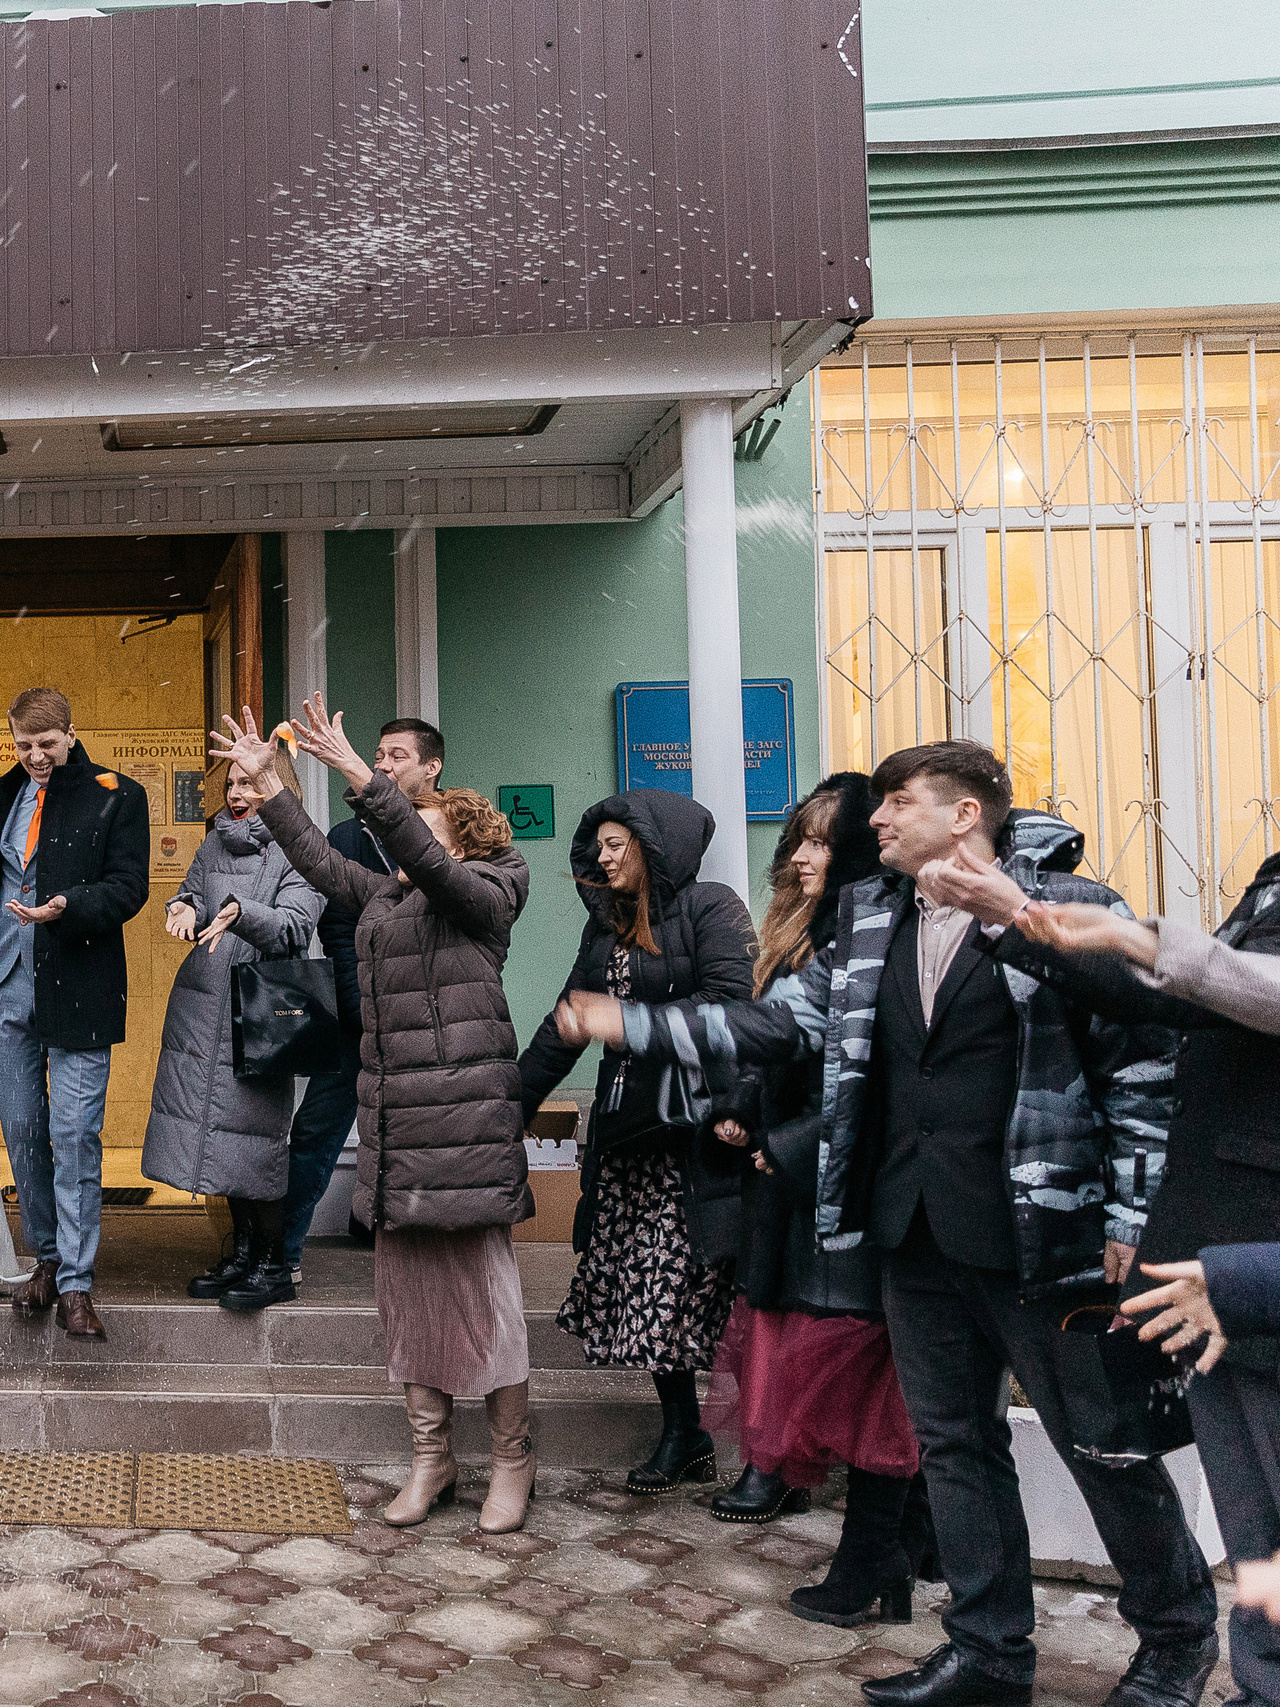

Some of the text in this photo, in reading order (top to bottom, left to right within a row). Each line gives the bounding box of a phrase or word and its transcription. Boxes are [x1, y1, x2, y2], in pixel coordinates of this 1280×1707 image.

[632, 743, 681, 752] ГЛАВНОЕ
[757, 740, 783, 749] ЗАГС
[644, 752, 692, 761] МОСКОВ
